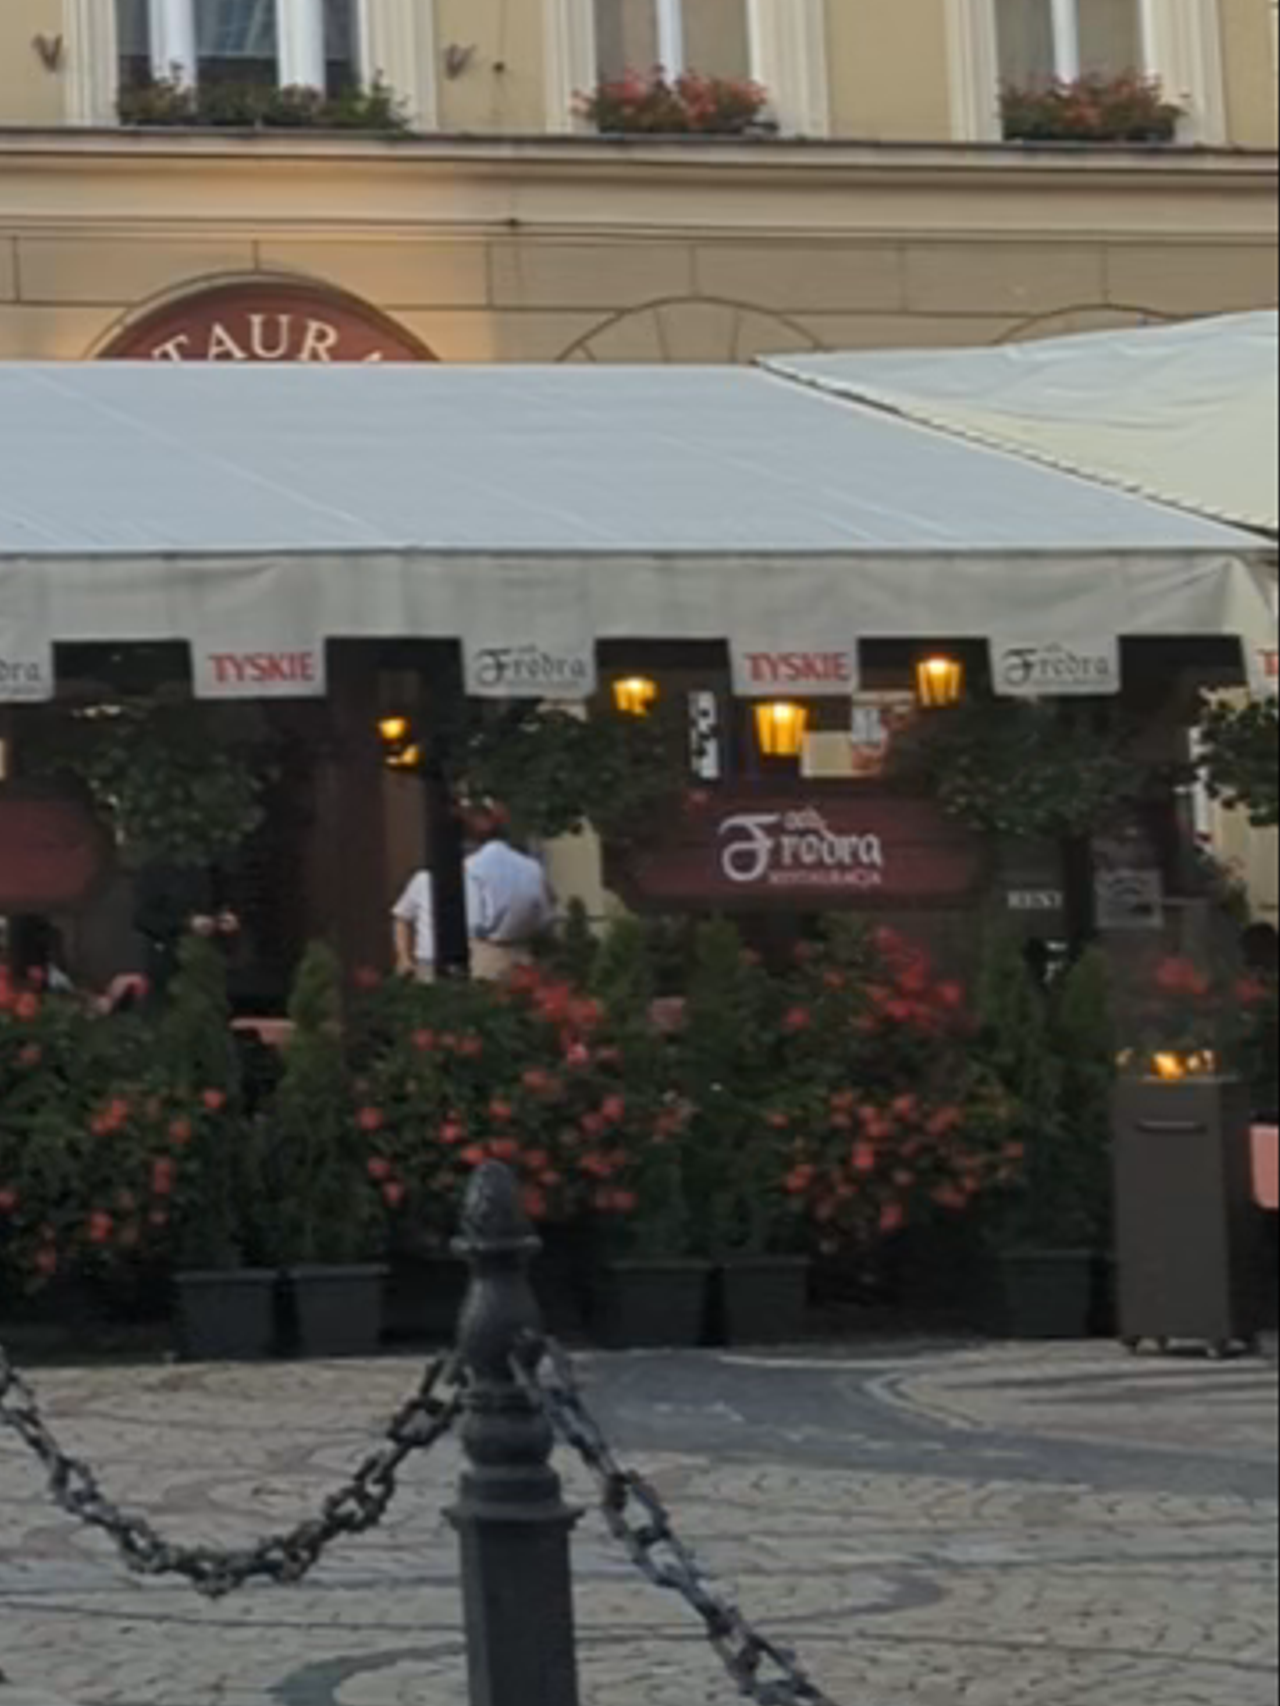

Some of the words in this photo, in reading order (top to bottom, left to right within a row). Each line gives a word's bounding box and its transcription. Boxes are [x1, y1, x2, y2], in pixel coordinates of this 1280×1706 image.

[151, 313, 383, 362] TAUR
[208, 651, 315, 682] TYSKIE
[744, 652, 849, 683] TYSKIE
